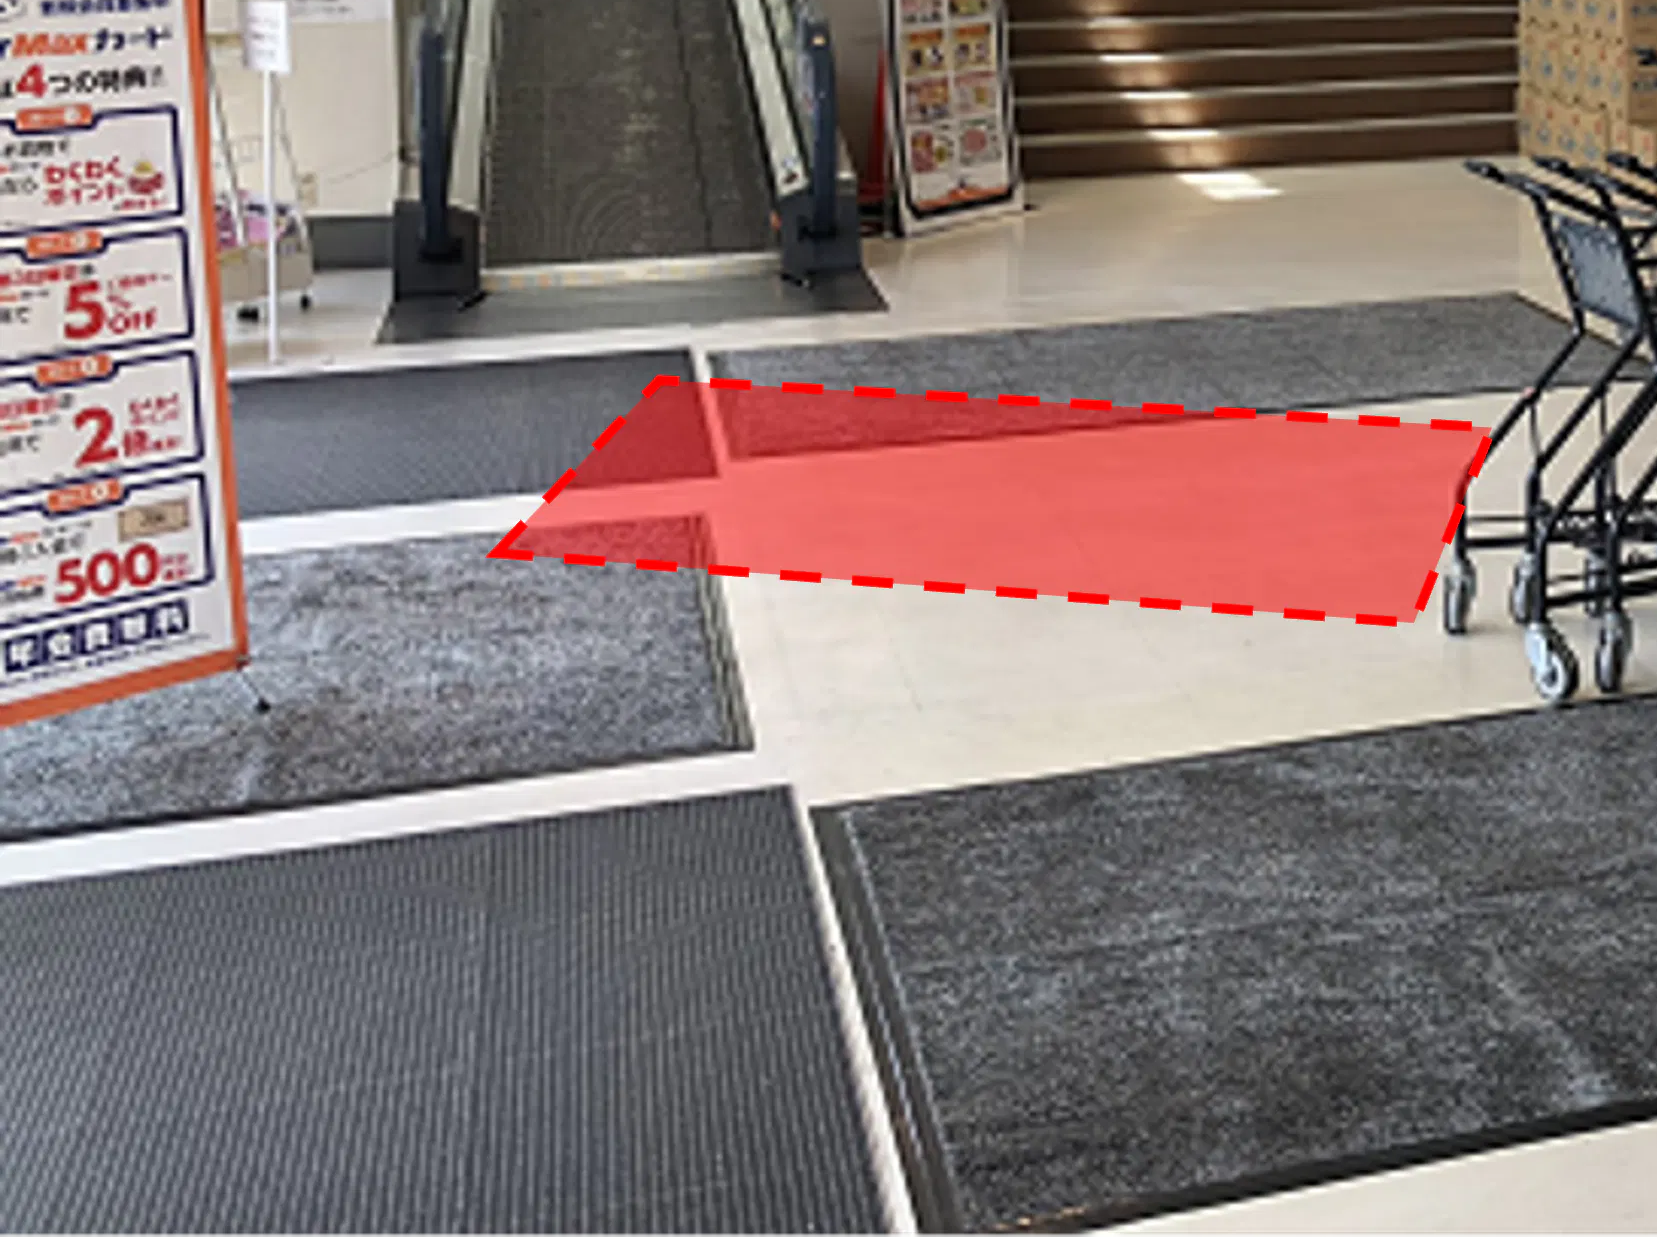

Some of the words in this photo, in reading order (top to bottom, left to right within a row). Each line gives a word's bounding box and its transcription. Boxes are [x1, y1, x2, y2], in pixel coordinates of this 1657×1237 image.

[64, 280, 105, 340] 5
[73, 406, 119, 469] 2
[54, 542, 160, 604] 500
